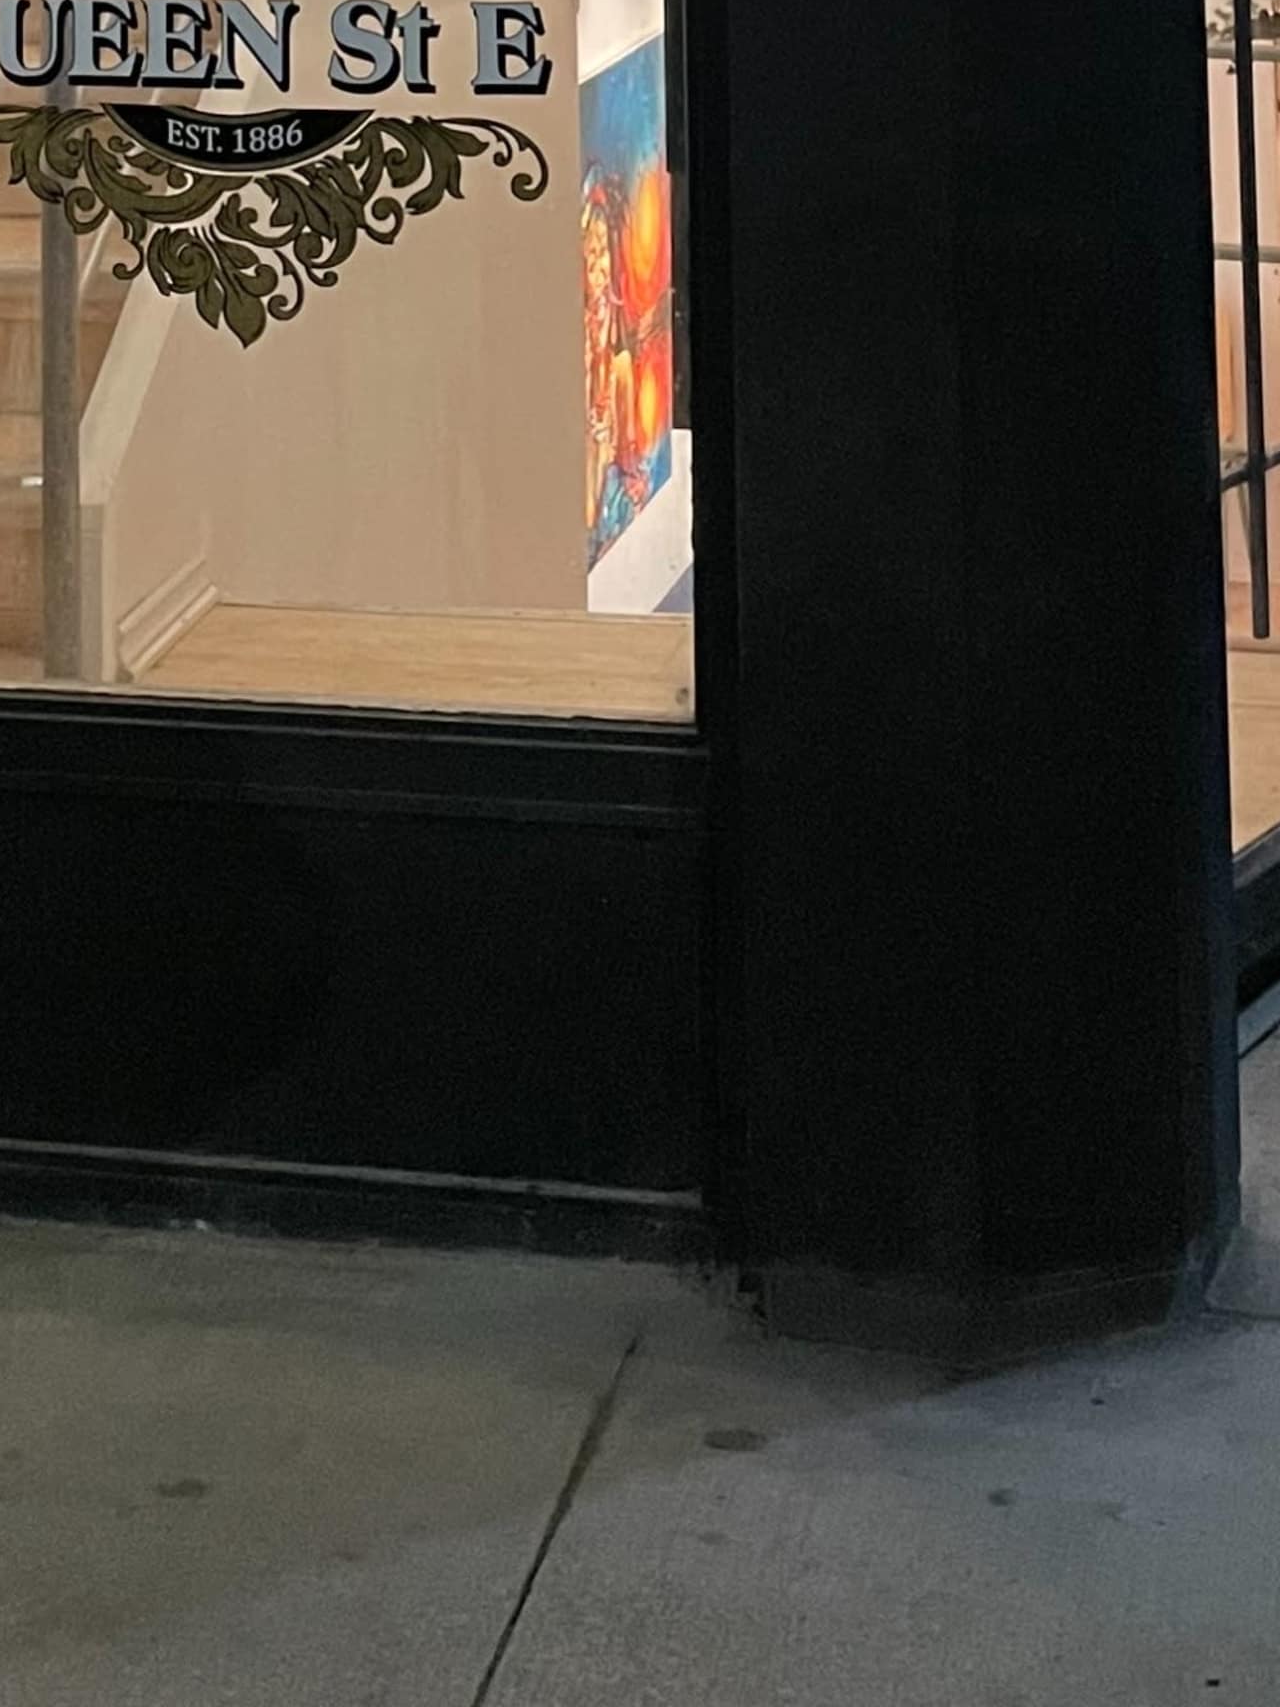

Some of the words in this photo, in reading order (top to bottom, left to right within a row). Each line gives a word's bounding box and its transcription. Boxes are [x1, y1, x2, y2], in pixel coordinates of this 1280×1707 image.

[471, 1, 553, 94] E
[166, 119, 223, 154] EST.
[232, 122, 304, 154] 1886
